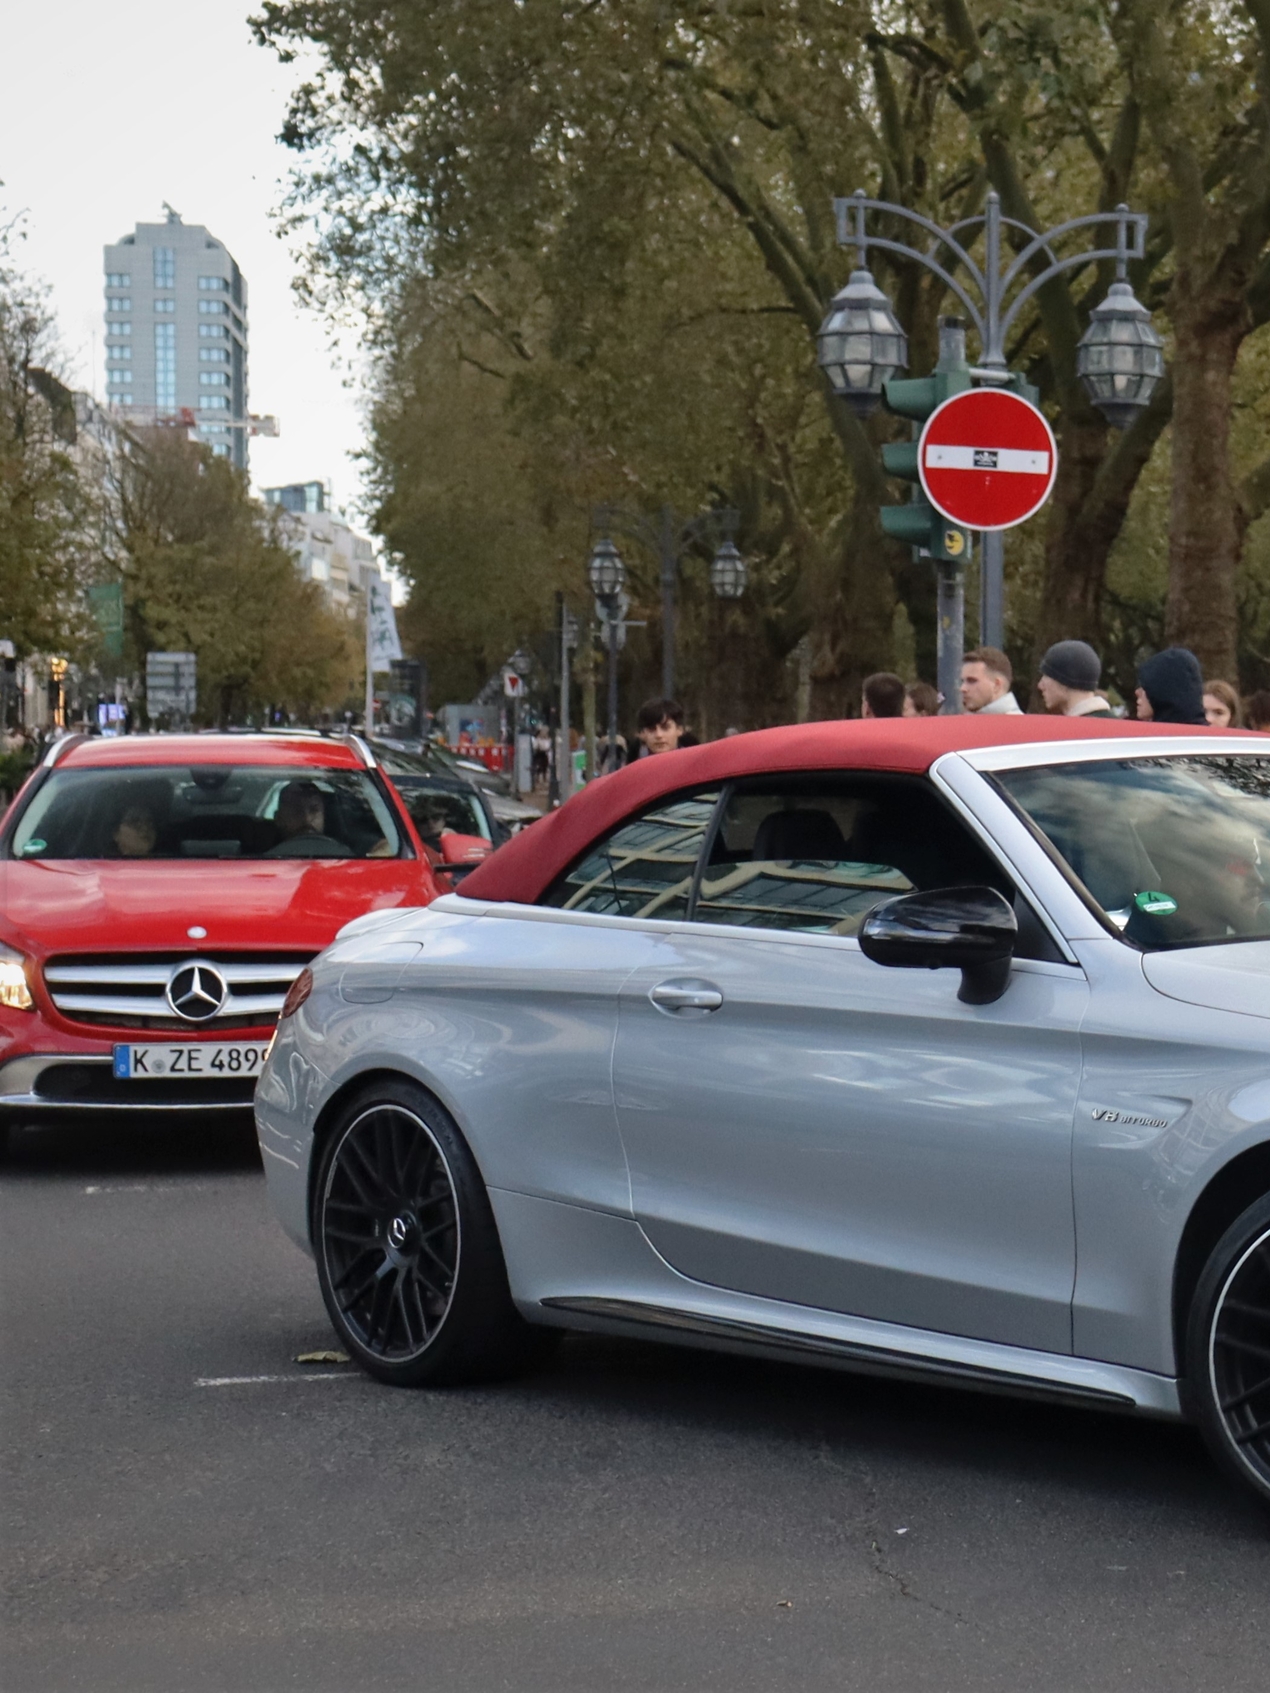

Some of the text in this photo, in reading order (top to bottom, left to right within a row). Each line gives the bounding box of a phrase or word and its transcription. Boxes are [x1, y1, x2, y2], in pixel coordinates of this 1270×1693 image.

[133, 1049, 149, 1073] K
[169, 1048, 203, 1073] ZE
[1092, 1108, 1119, 1123] V8
